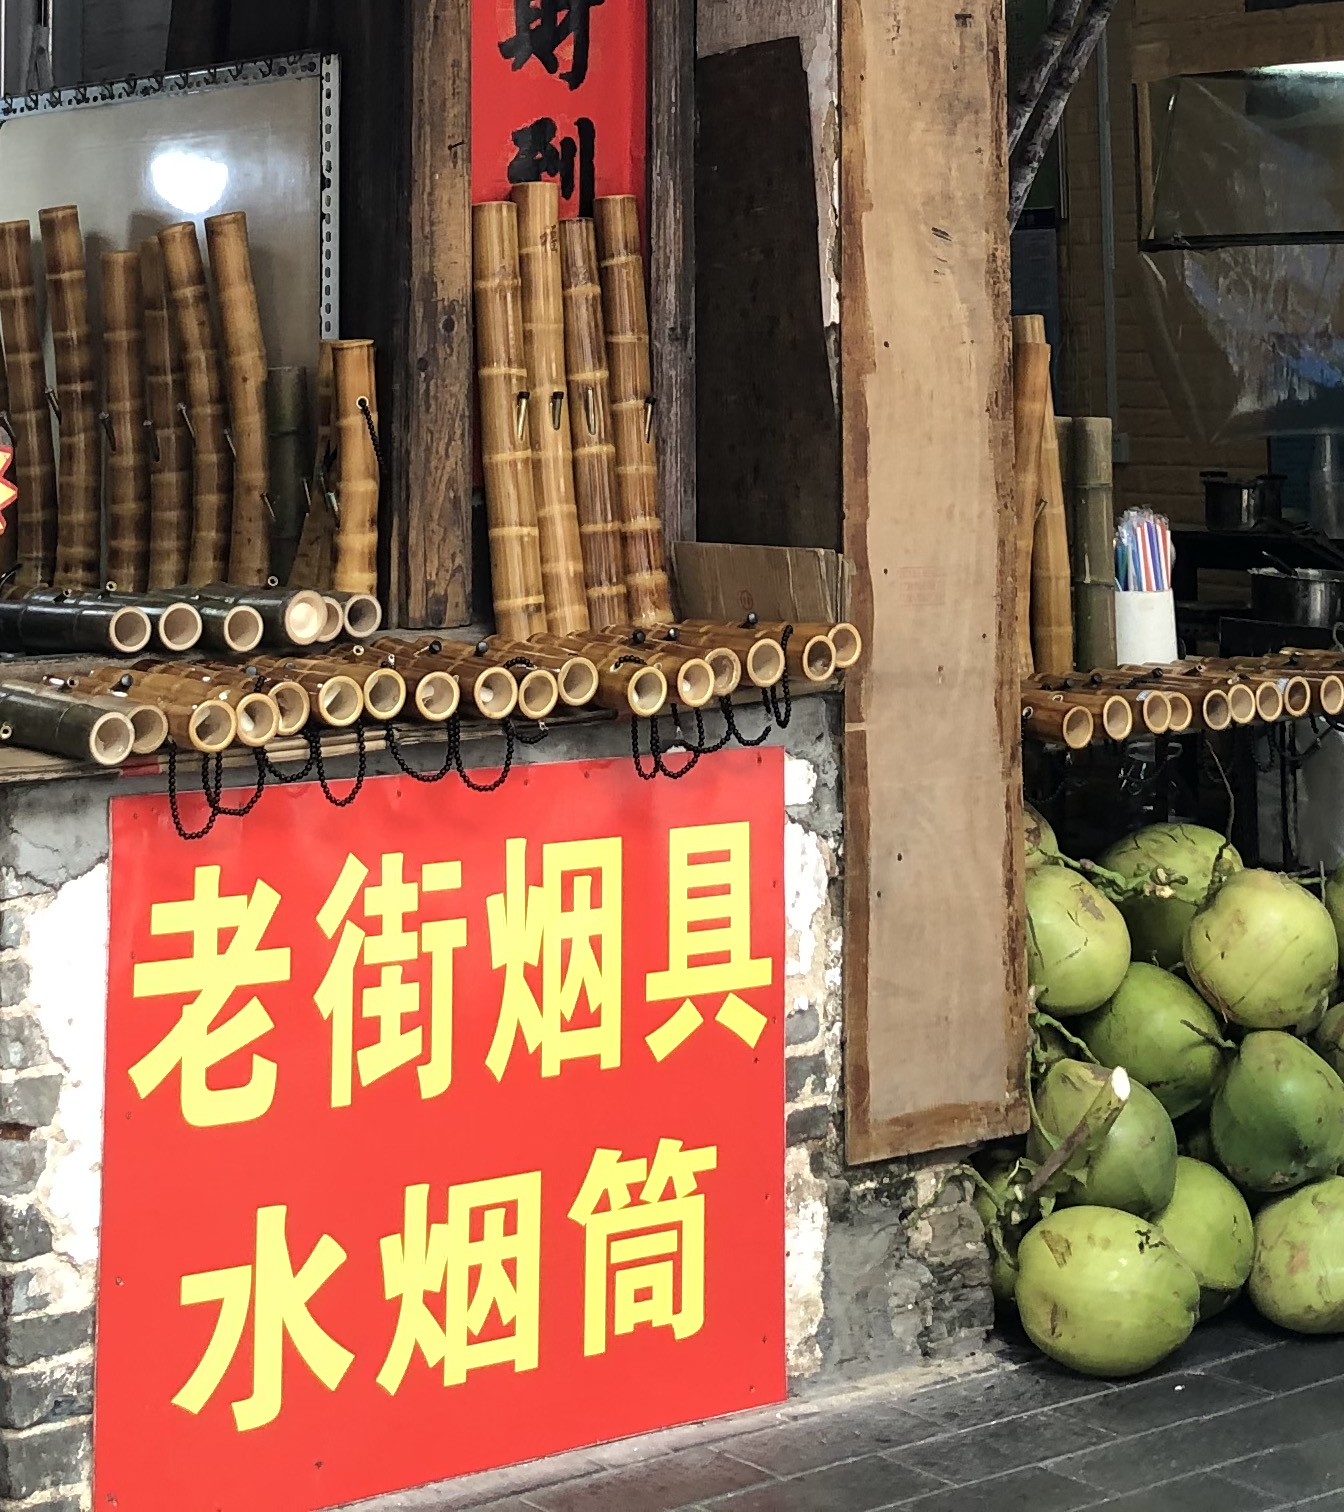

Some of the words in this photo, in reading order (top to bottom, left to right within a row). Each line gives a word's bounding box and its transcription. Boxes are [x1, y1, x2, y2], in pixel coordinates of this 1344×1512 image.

[127, 821, 773, 1128] 老街烟具
[171, 1137, 719, 1433] 水烟筒
